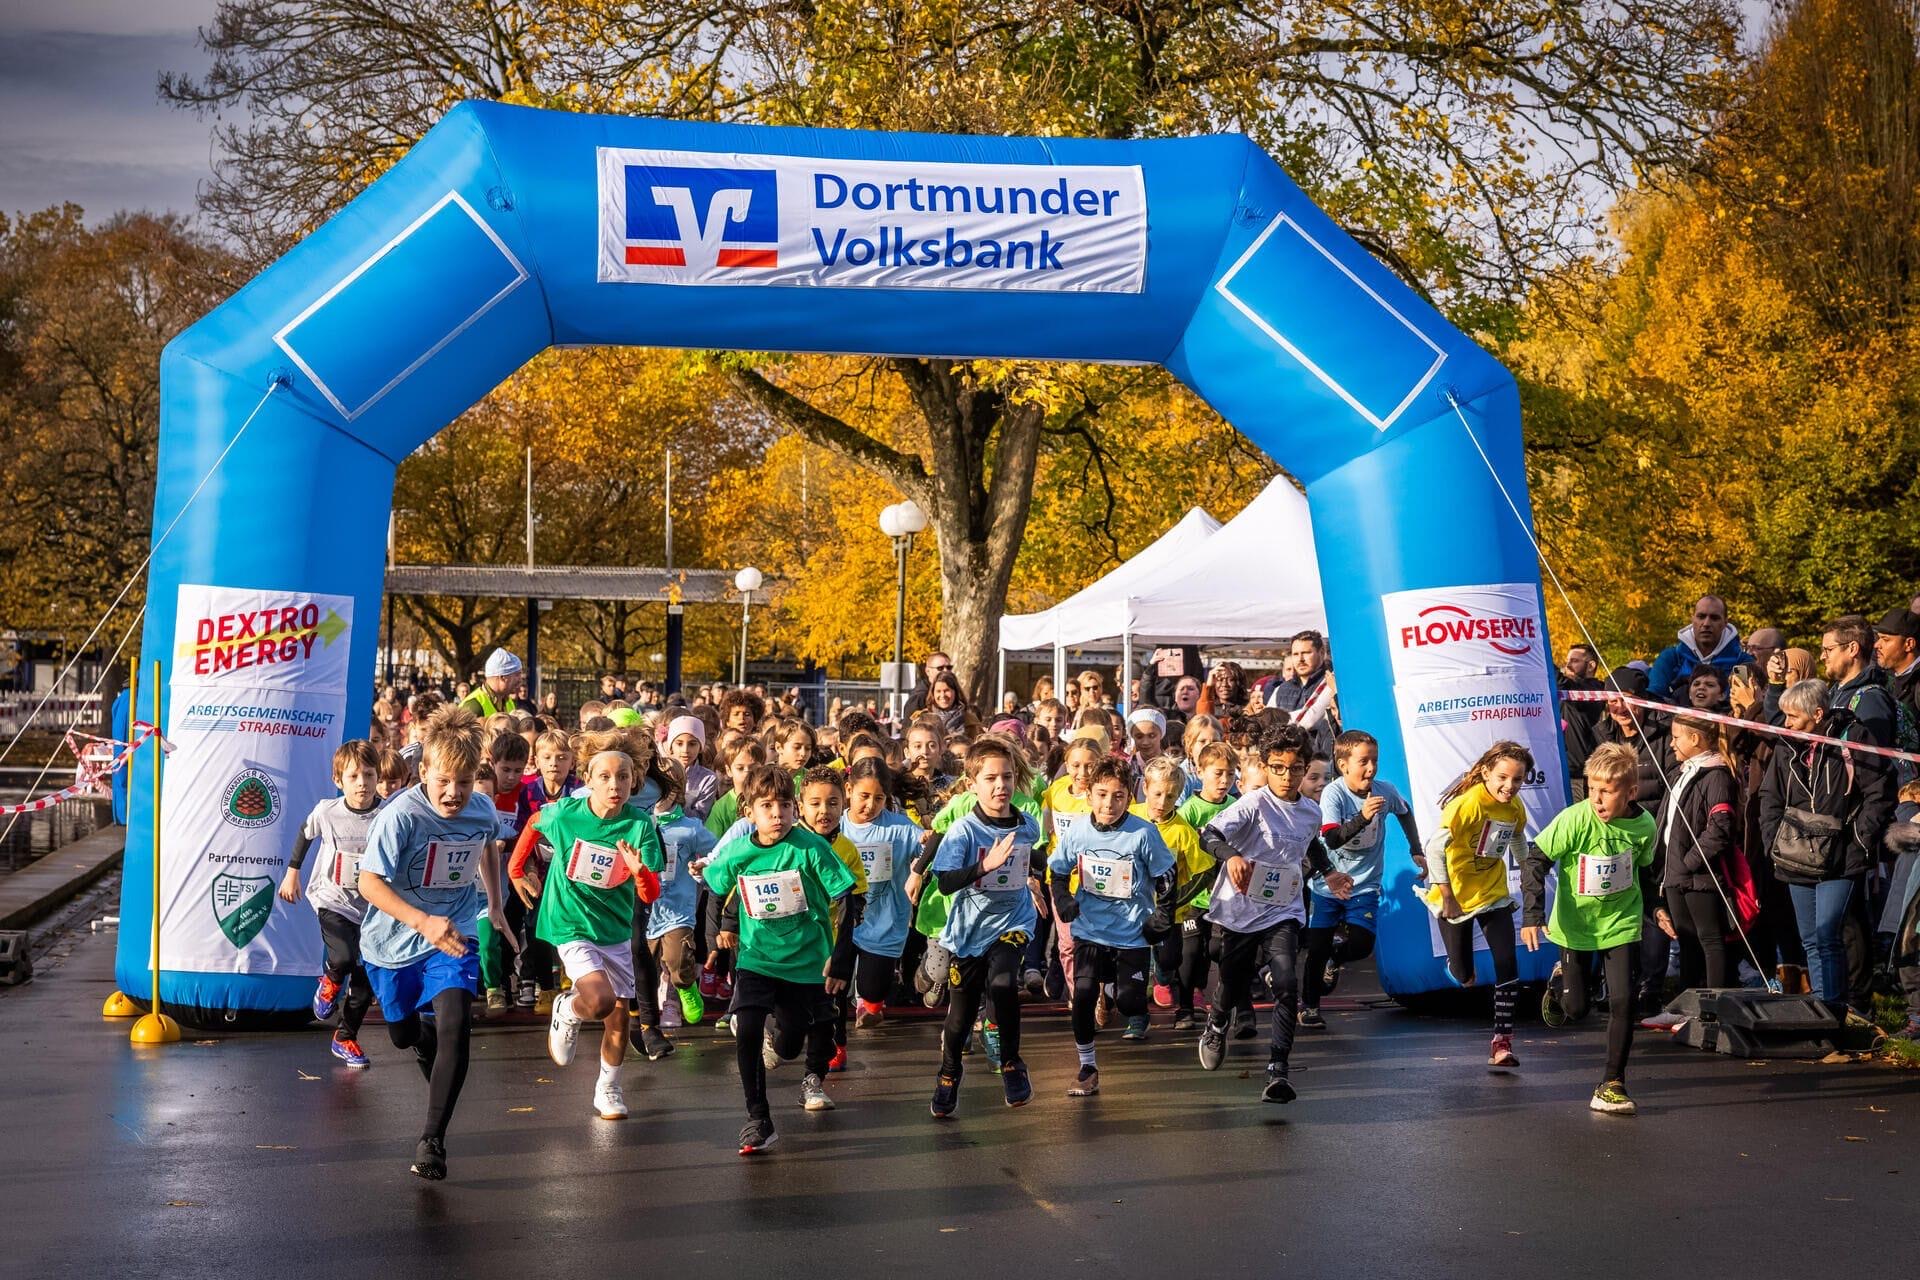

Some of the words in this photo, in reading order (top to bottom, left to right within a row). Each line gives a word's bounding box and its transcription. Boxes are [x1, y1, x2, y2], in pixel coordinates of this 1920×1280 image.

[814, 173, 1120, 217] Dortmunder
[812, 226, 1065, 270] Volksbank
[196, 603, 319, 646] DEXTRO
[1401, 617, 1536, 648] FLOWSERVE
[194, 632, 319, 675] ENERGY
[1418, 693, 1544, 713] ARBEITSGEMEINSCHAFT
[187, 705, 336, 725] ARBEITSGEMEINSCHAFT
[1471, 707, 1542, 721] STRAßENLAUF
[238, 720, 327, 738] STRAßENLAUF
[258, 772, 279, 809] WALDLAUF
[223, 808, 277, 827] GEMEINSCHAFT
[1056, 818, 1071, 827] 157
[208, 853, 284, 866] Partnerverein
[447, 850, 471, 863] 177
[591, 853, 613, 867] 182
[1092, 864, 1111, 877] 152
[1596, 863, 1617, 874] 173
[1265, 871, 1280, 883] 34
[240, 883, 257, 893] TSV
[755, 882, 780, 896] 146
[1183, 919, 1197, 931] MR
